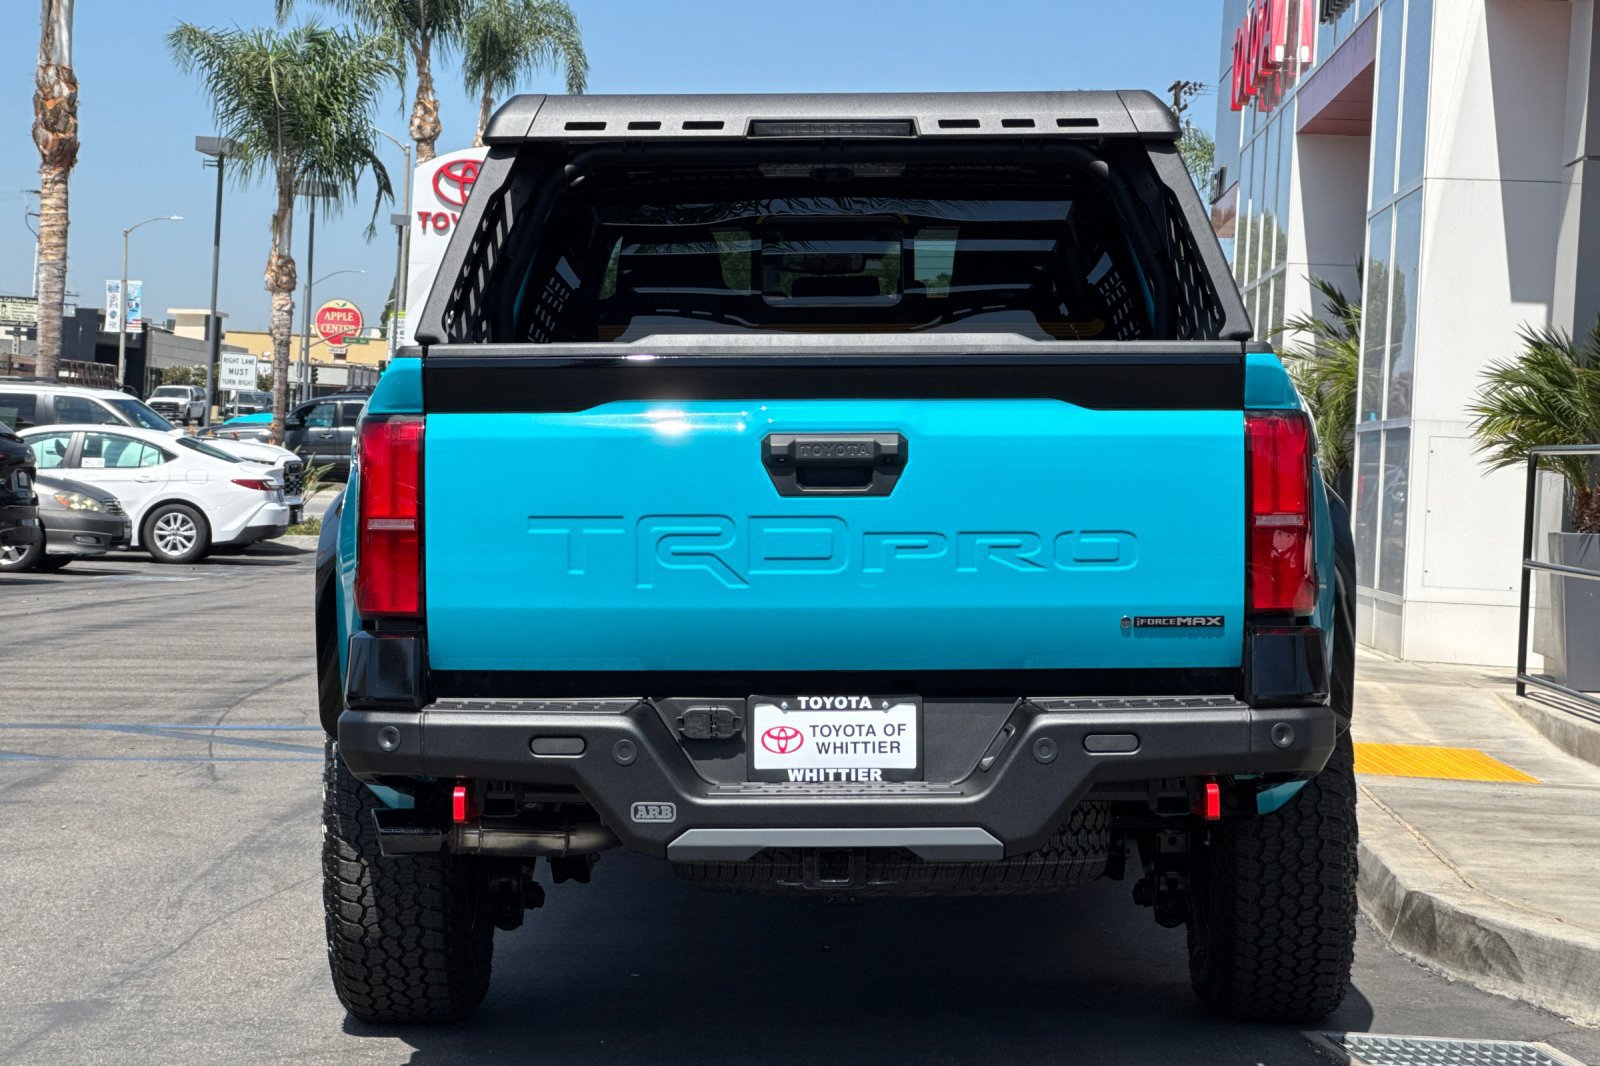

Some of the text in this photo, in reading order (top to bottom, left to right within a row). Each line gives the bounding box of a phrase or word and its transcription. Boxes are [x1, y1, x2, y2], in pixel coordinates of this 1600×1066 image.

[324, 311, 354, 322] APPLE
[320, 323, 356, 335] CENTER
[241, 357, 256, 366] LANE
[228, 367, 249, 376] MUST
[222, 378, 254, 387] TURN RIGHT
[800, 443, 870, 457] TOYOTA
[527, 513, 1139, 589] TRD PRO
[797, 696, 873, 710] TOYOTA
[809, 723, 907, 738] TOYOTA OF
[816, 741, 901, 755] WHITTIER
[787, 768, 883, 782] WHITTIER
[635, 805, 673, 819] ARB
